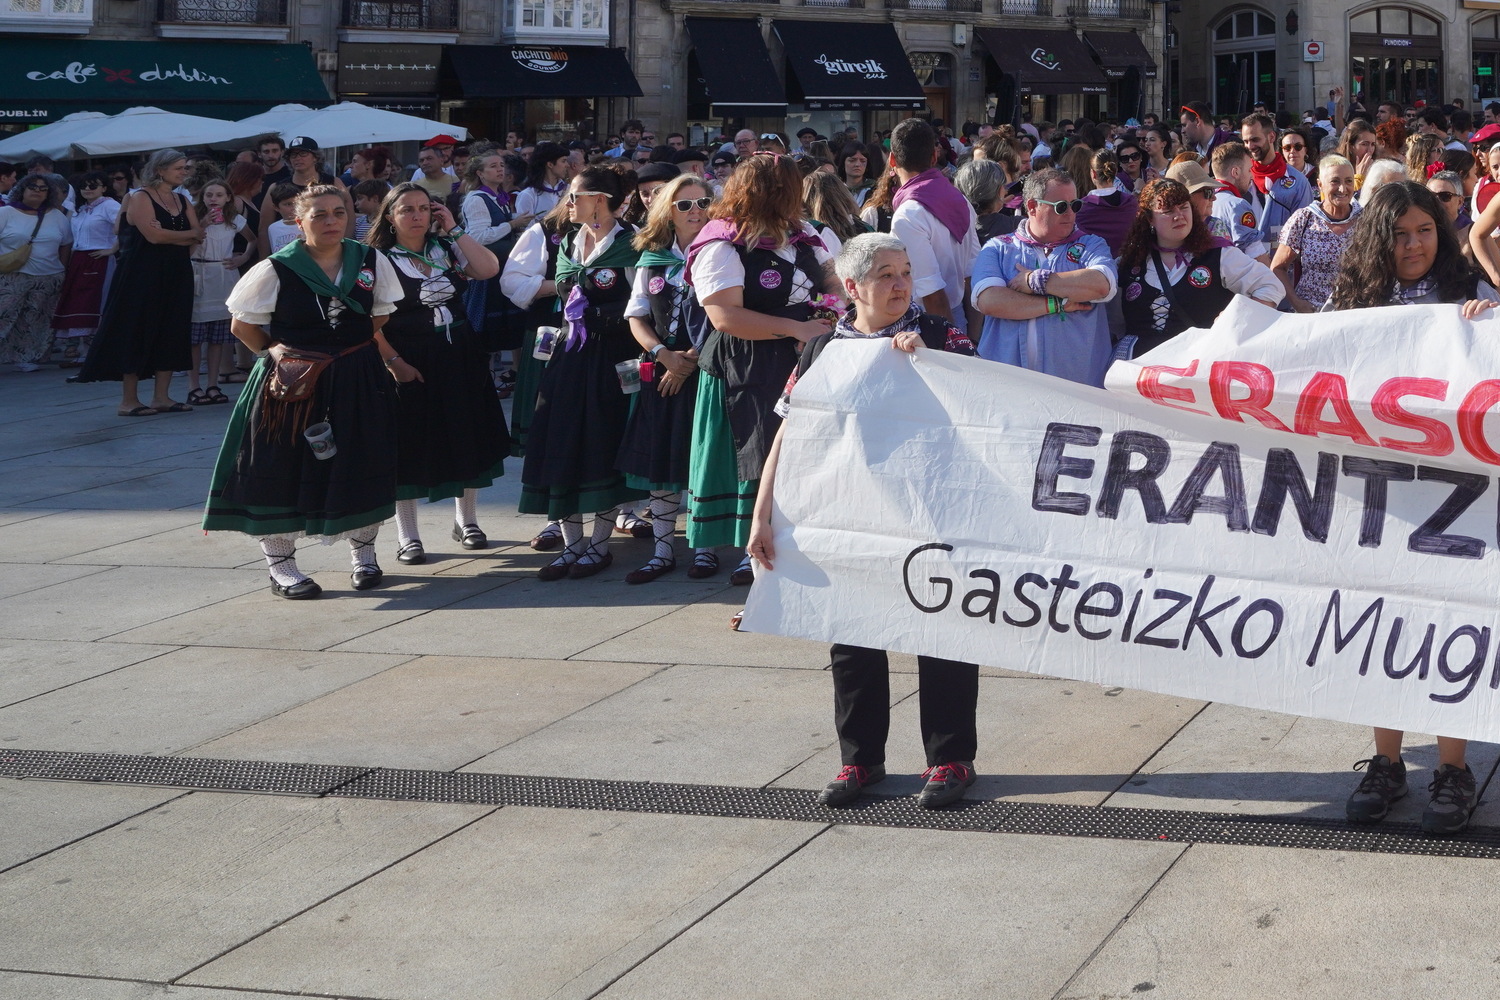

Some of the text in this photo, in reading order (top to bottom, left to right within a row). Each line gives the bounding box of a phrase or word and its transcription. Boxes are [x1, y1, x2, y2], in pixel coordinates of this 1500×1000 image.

[26, 61, 233, 85] café dublin
[349, 63, 432, 71] IKURRAK
[527, 62, 561, 71] GOURMET
[824, 59, 886, 76] güreik
[902, 543, 1284, 659] Gasteizko
